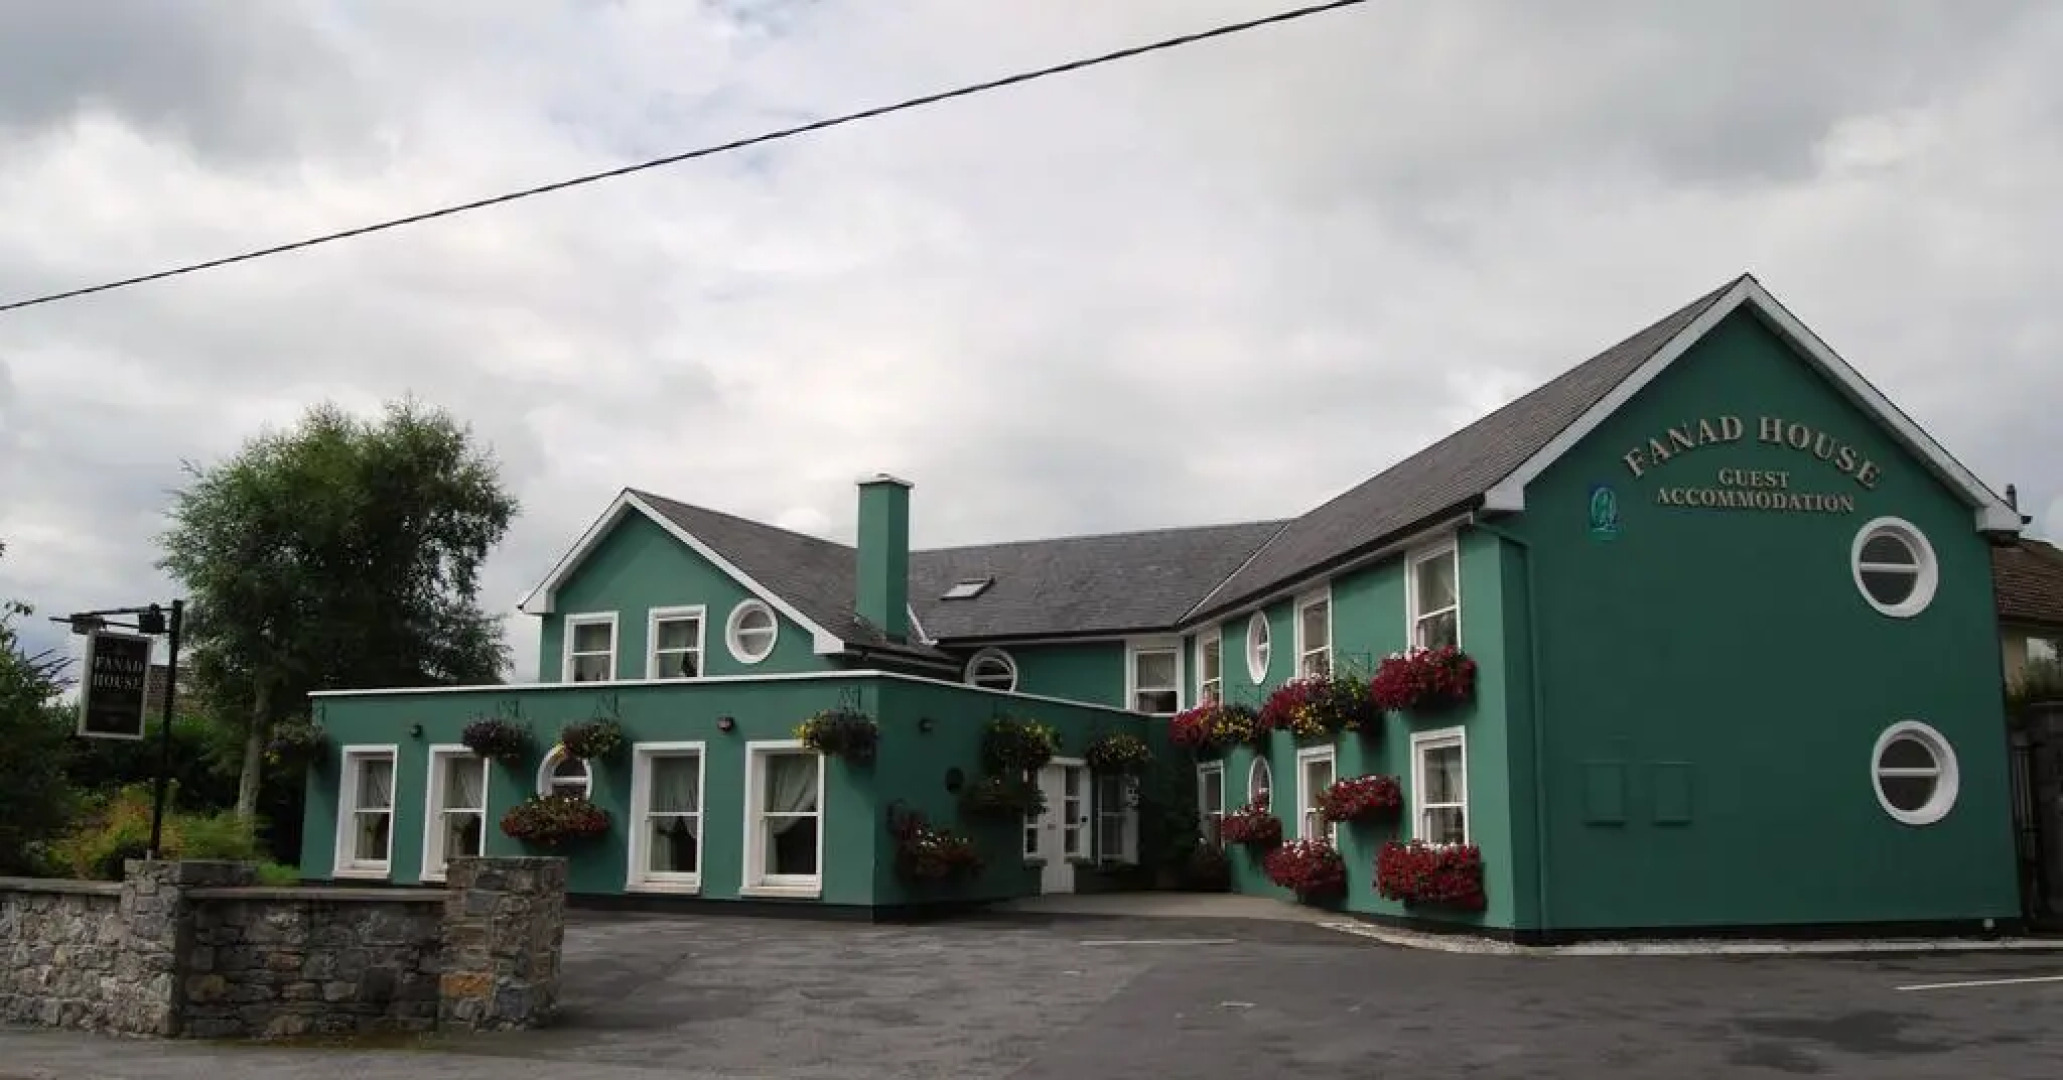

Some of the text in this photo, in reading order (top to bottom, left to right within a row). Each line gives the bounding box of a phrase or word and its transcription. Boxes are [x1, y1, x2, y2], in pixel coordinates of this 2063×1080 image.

[1623, 416, 1881, 488] FANAD HOUSE
[1718, 468, 1790, 488] GUEST
[1657, 487, 1854, 512] ACCOMMODATION
[93, 673, 144, 690] HOUSE
